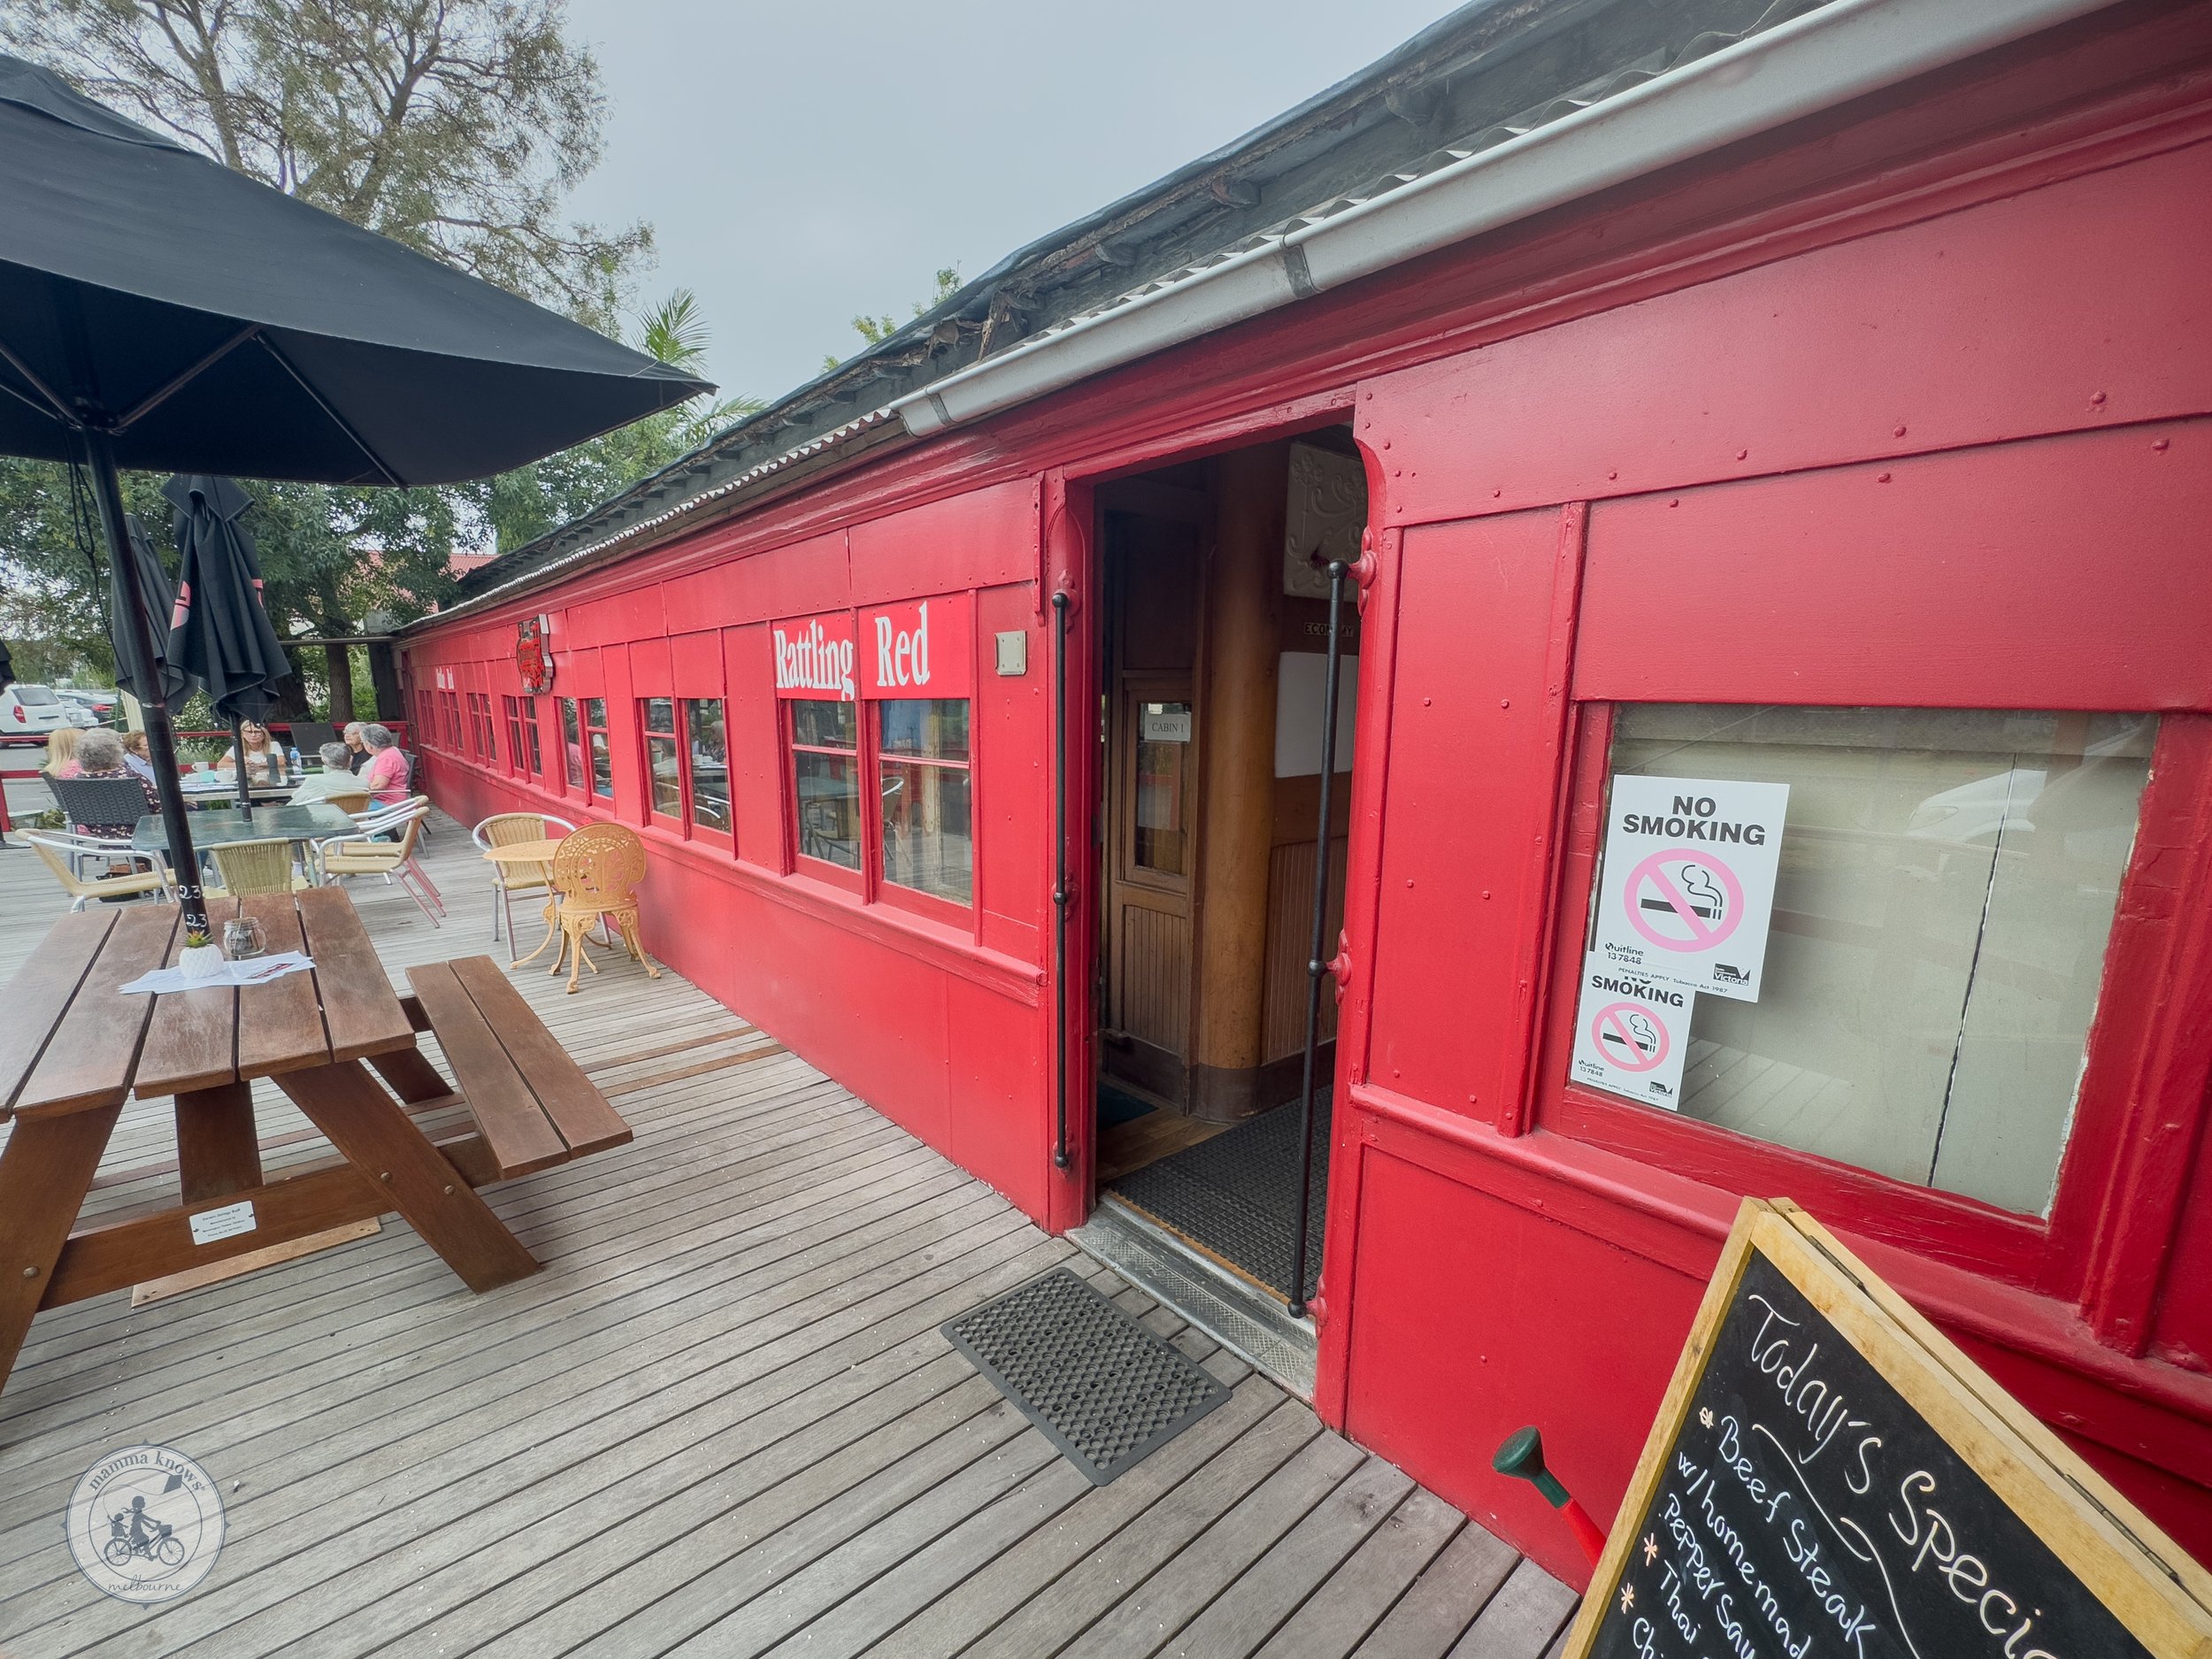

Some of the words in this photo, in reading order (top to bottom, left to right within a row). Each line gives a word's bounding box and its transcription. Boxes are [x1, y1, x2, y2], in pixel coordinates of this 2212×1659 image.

[773, 618, 856, 702] Rattling
[874, 601, 930, 687] Red
[1151, 722, 1178, 733] CABIN
[1672, 795, 1717, 818] NO
[1622, 814, 1766, 846] SMOKING
[179, 885, 202, 899] 23
[186, 913, 209, 928] 23
[1591, 975, 1684, 1008] SMOKING
[1650, 973, 1671, 982] APPLY
[1719, 1416, 1791, 1523] Beef
[1748, 1295, 1882, 1494] Today's
[1889, 1471, 2057, 1659] Speci
[1660, 1559, 1701, 1644] Thai
